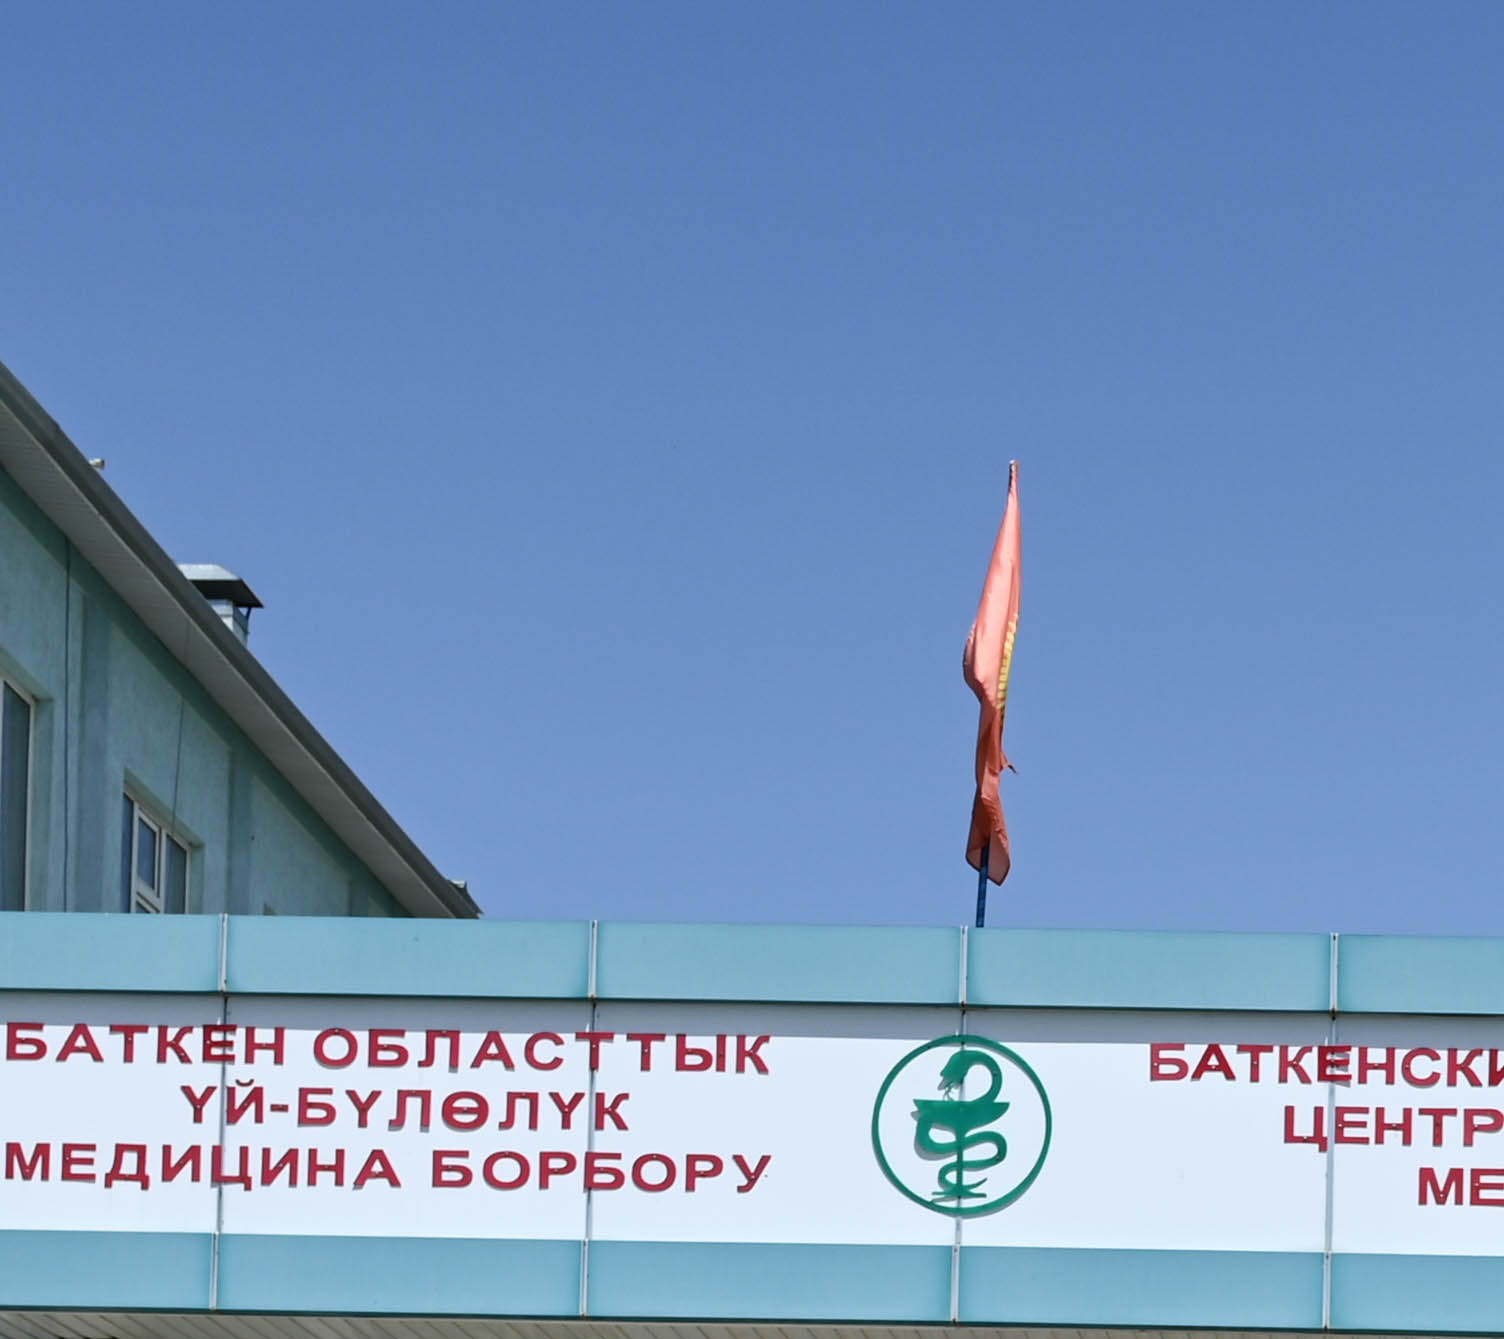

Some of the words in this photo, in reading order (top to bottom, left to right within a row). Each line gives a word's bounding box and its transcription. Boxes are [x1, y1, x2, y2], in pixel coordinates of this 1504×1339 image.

[6, 1021, 286, 1065] БАТКЕН
[314, 1028, 771, 1074] ОБЛАСТТЫК
[182, 1078, 632, 1132] ҮЙ-БҮЛӨЛҮК
[6, 1141, 402, 1191] МЕДИЦИНА
[433, 1148, 771, 1193] БОРБОРУ
